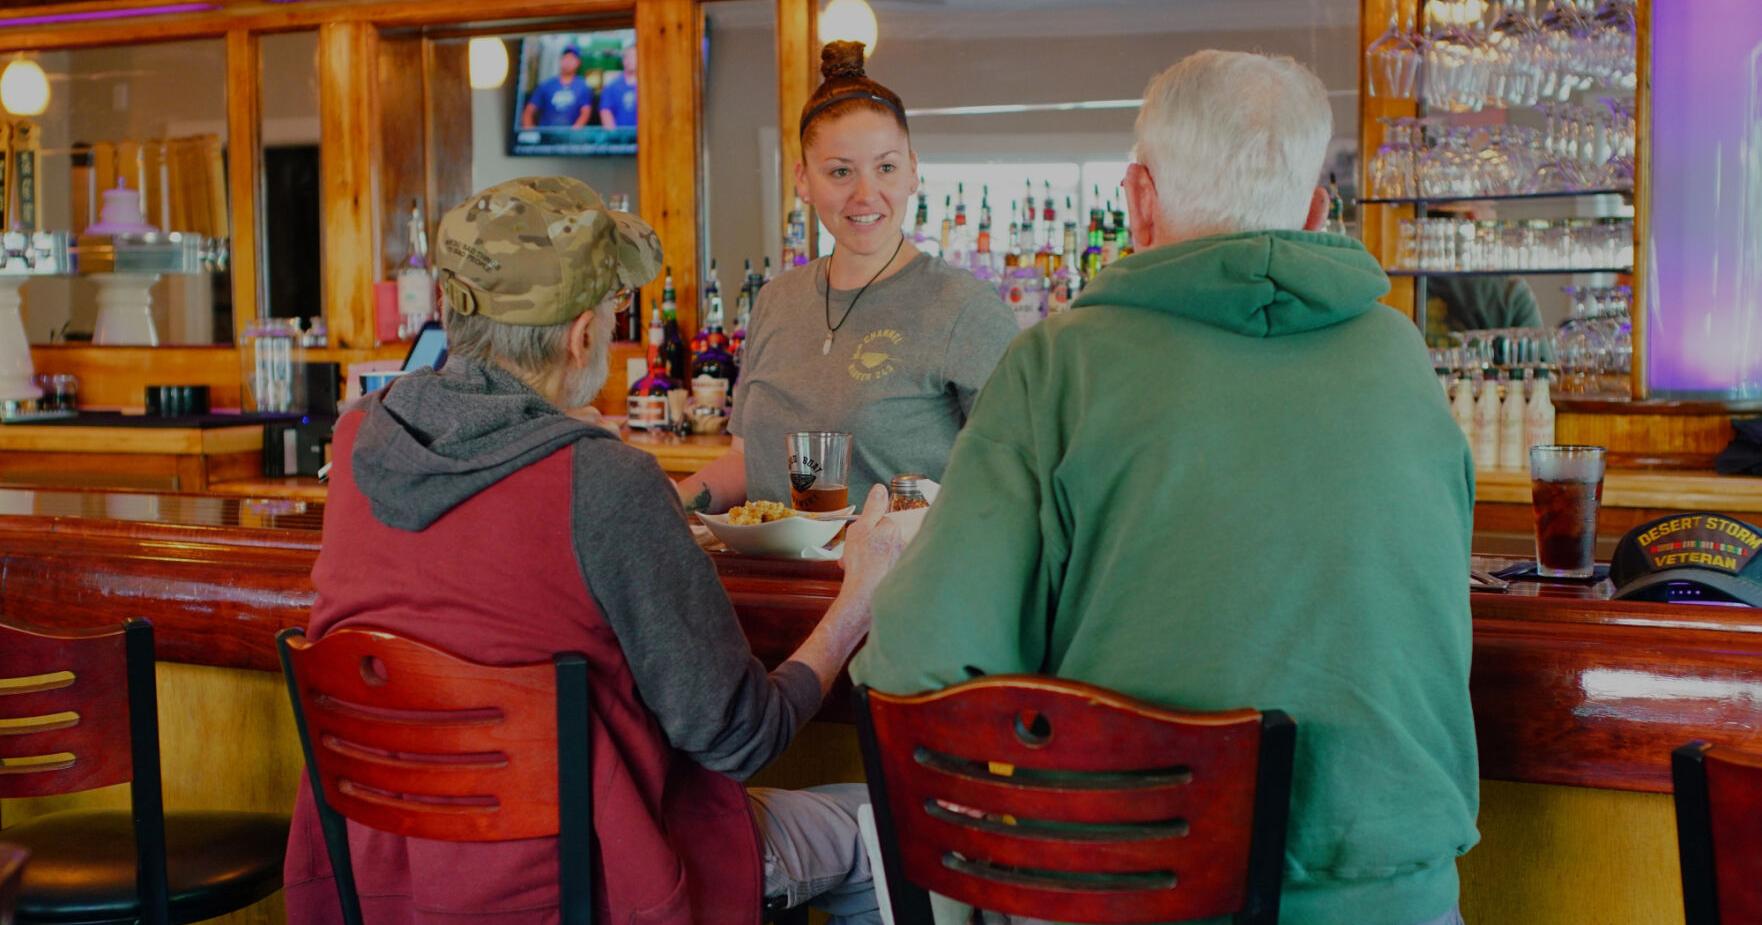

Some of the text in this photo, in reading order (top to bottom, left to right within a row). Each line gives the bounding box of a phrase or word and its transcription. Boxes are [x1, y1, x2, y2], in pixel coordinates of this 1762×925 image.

[864, 328, 905, 345] CHANNEL
[803, 456, 824, 473] BOAT
[1637, 516, 1762, 550] DESERT STORM
[1654, 552, 1737, 570] VETERAN
